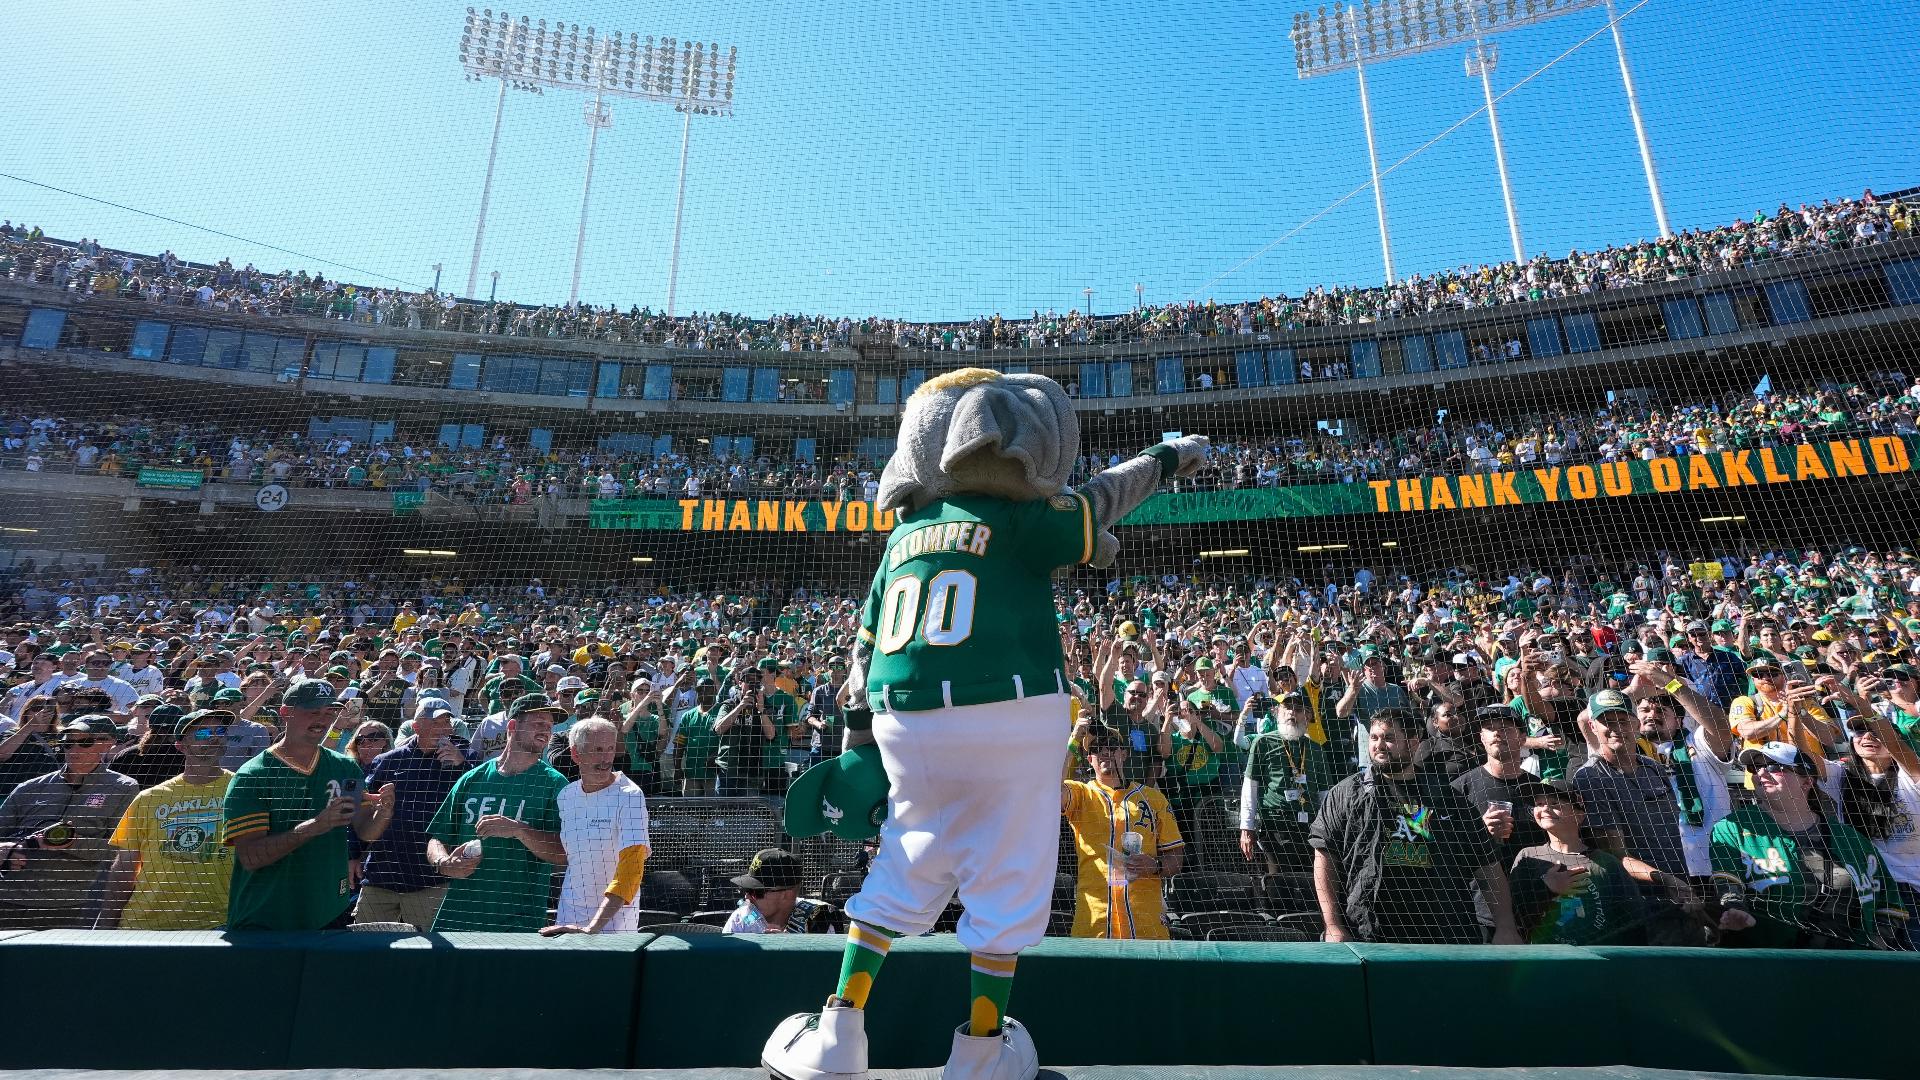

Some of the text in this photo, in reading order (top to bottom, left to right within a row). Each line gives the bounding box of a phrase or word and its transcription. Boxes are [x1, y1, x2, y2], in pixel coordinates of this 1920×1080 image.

[260, 490, 283, 504] 24
[1368, 436, 1910, 512] THANK YOU OAKLAND
[679, 499, 807, 531] THANK
[889, 521, 992, 569] STOMPER
[880, 569, 978, 656] 00
